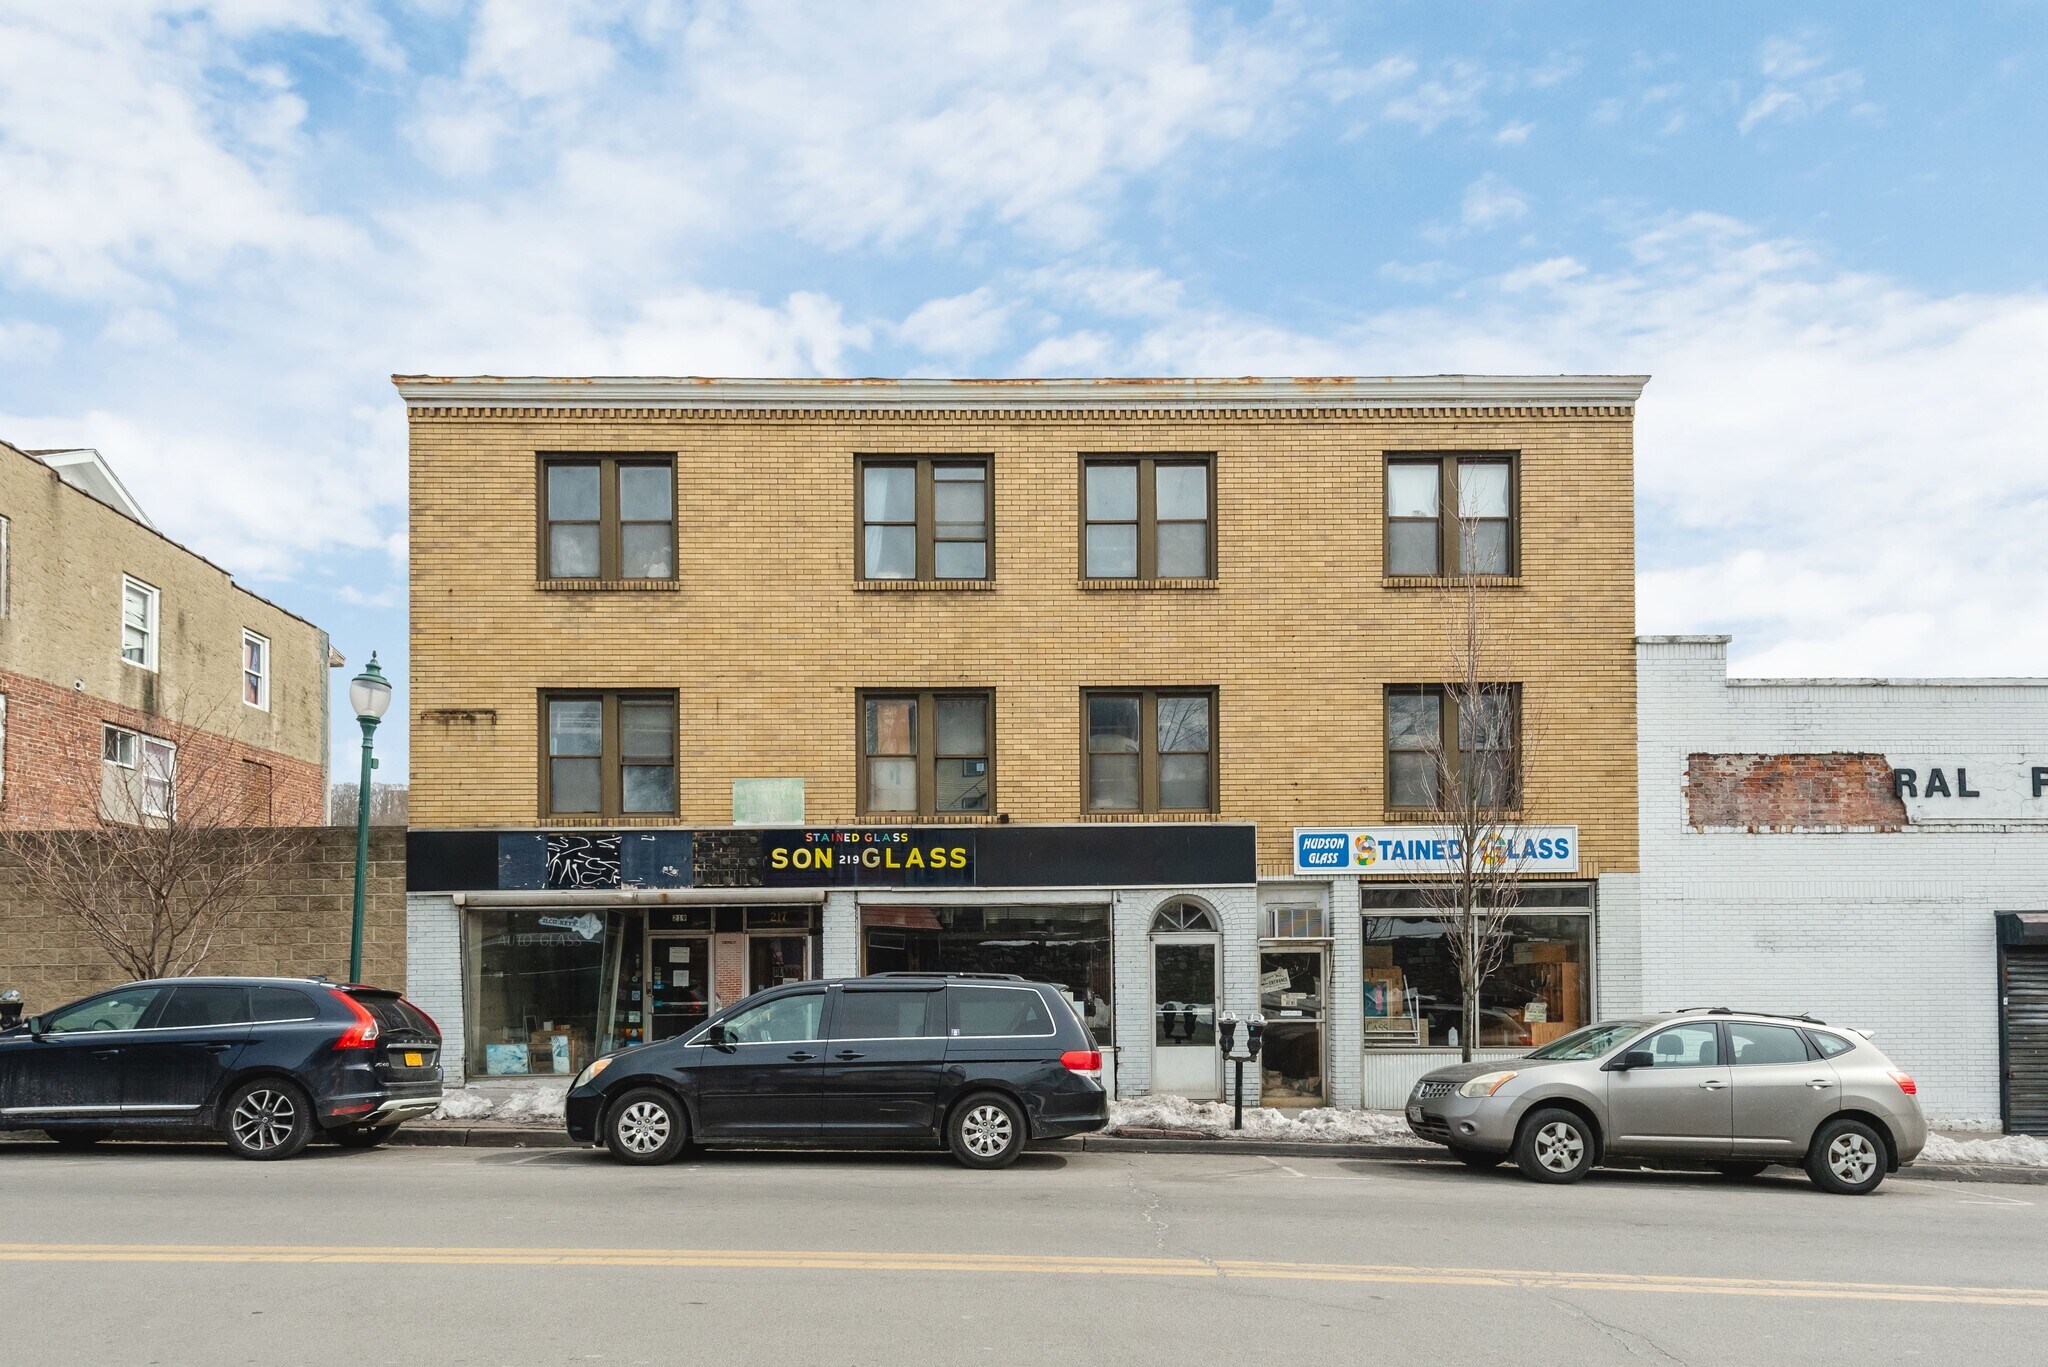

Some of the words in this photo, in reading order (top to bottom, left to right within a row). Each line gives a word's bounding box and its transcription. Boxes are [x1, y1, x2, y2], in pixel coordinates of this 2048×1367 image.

[1893, 767, 1980, 798] RAL
[805, 832, 860, 843] STAINED
[864, 832, 908, 843] GLASS
[1303, 837, 1346, 851] HUDSON
[1353, 834, 1462, 866] STAINED
[1478, 833, 1570, 865] GLASS
[771, 847, 833, 869] SON
[838, 855, 860, 865] 219
[861, 847, 967, 869] GLASS
[1308, 852, 1339, 865] GLASS
[770, 911, 789, 923] 217
[500, 934, 533, 947] AUTO
[540, 934, 582, 947] GLASS
